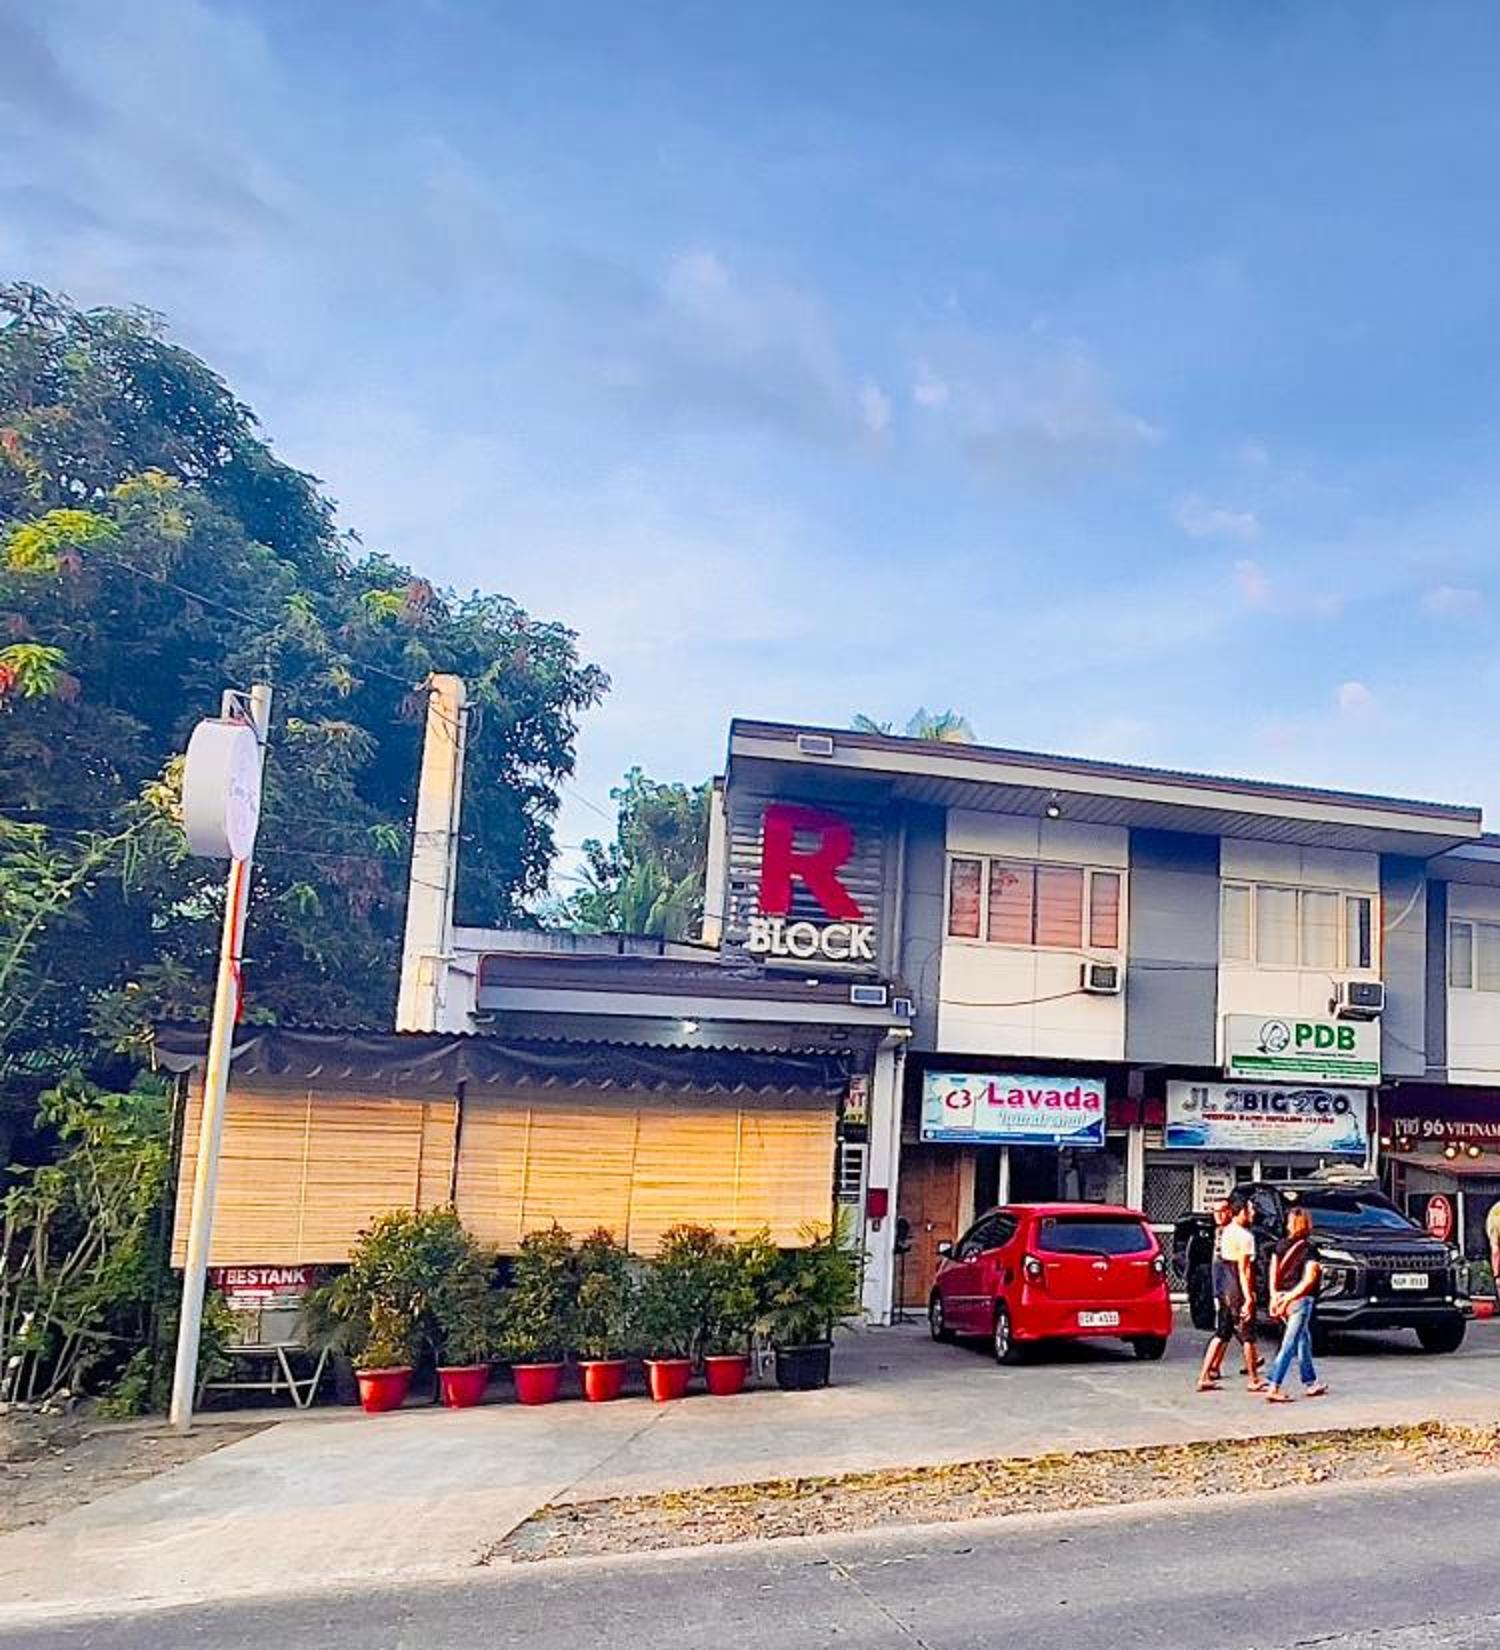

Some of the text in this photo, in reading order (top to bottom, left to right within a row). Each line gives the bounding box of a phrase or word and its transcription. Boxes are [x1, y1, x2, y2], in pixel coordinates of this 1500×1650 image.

[758, 804, 864, 919] R
[747, 917, 876, 959] BLOCK
[1295, 1023, 1356, 1050] PDB
[986, 1082, 1100, 1110] Lavada
[1423, 1119, 1445, 1137] 96
